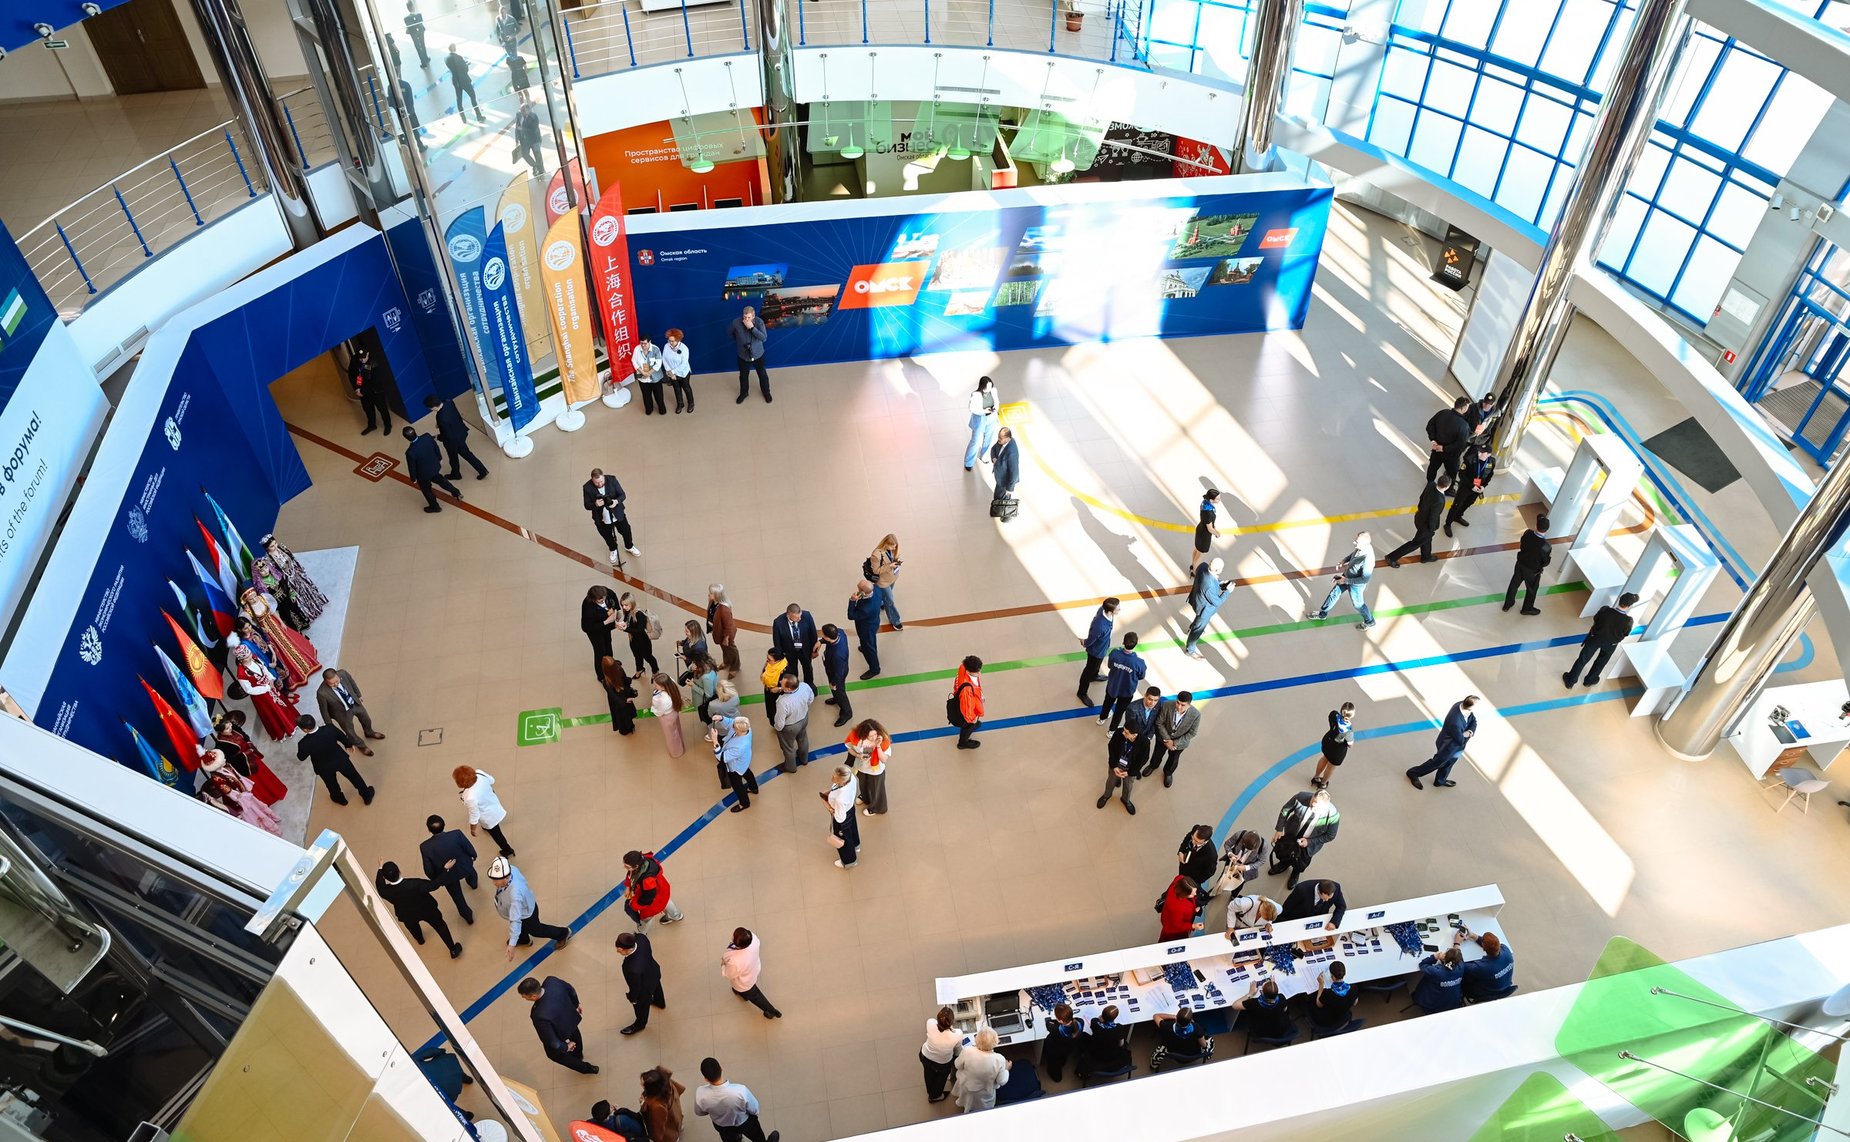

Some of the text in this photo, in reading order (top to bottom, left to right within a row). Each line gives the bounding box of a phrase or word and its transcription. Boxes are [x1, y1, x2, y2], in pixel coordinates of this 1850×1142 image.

[625, 146, 680, 157] Пространство
[631, 155, 669, 164] сервисов
[670, 153, 684, 161] для
[555, 282, 567, 331] cooperation
[567, 279, 579, 330] organisation
[603, 255, 632, 361] 上海合作组织
[854, 276, 914, 294] ОМСК
[494, 301, 510, 357] организация
[502, 295, 521, 364] сотрудничества
[505, 358, 523, 410] Шанхайская
[4, 410, 42, 483] форума!
[7, 519, 17, 539] of
[13, 501, 27, 524] the
[23, 458, 48, 502] forum!
